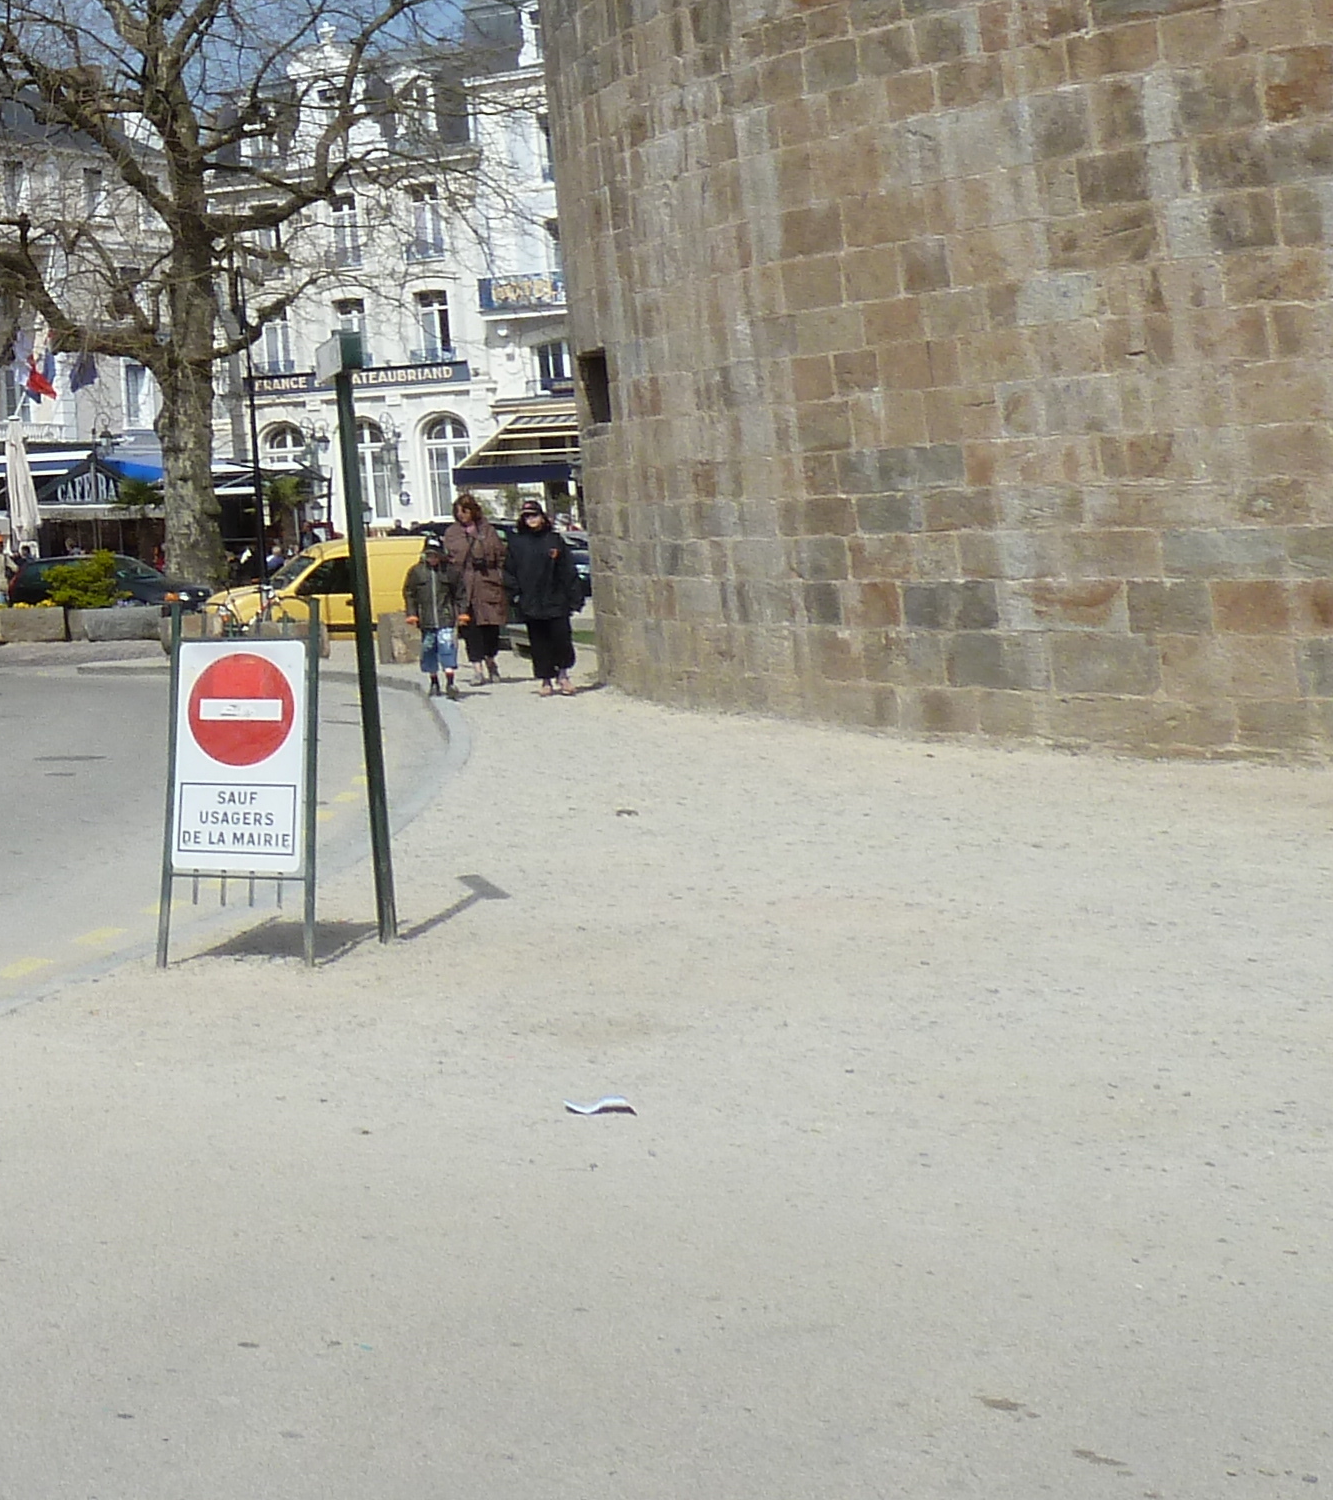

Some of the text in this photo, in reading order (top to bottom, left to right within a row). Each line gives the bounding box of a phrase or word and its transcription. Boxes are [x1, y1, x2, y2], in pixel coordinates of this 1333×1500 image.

[255, 376, 307, 392] FRANCE
[352, 366, 453, 385] ATEAUBRIAND
[217, 790, 258, 805] SAUF
[199, 810, 274, 826] USAGERS
[182, 830, 291, 848] DE LA MAIRIE
